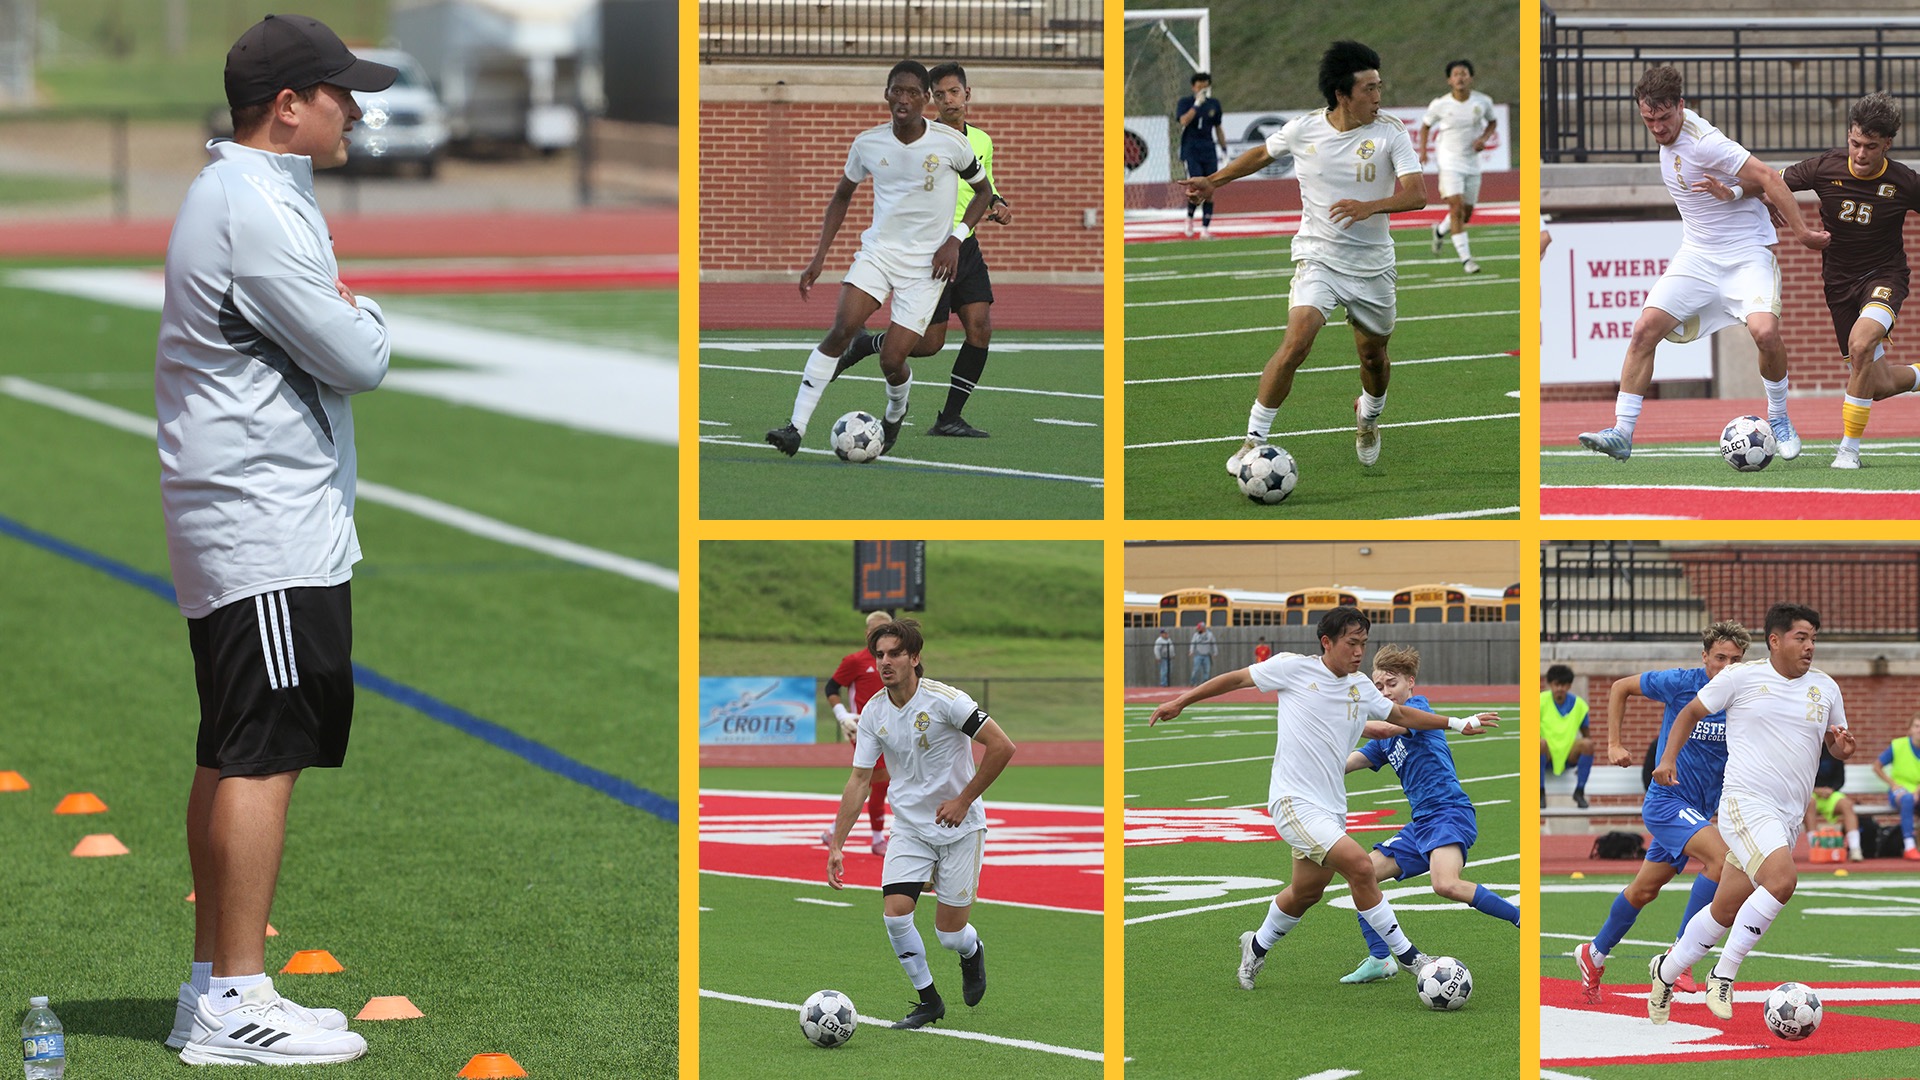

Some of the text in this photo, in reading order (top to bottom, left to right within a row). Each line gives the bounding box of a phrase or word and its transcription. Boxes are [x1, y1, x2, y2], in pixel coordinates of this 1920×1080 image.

[1355, 162, 1376, 182] 10
[924, 175, 935, 191] 8
[1838, 200, 1874, 226] 25
[1587, 258, 1670, 279] WHERE
[1589, 321, 1633, 340] ARE
[1721, 438, 1747, 456] SELECT
[723, 715, 796, 735] CROTTS
[1695, 720, 1727, 735] ESTE
[917, 733, 930, 750] 4
[1679, 807, 1707, 826] 10
[1444, 967, 1465, 998] SELECT
[821, 1018, 851, 1039] SELECT
[1767, 1012, 1799, 1035] SELECT
